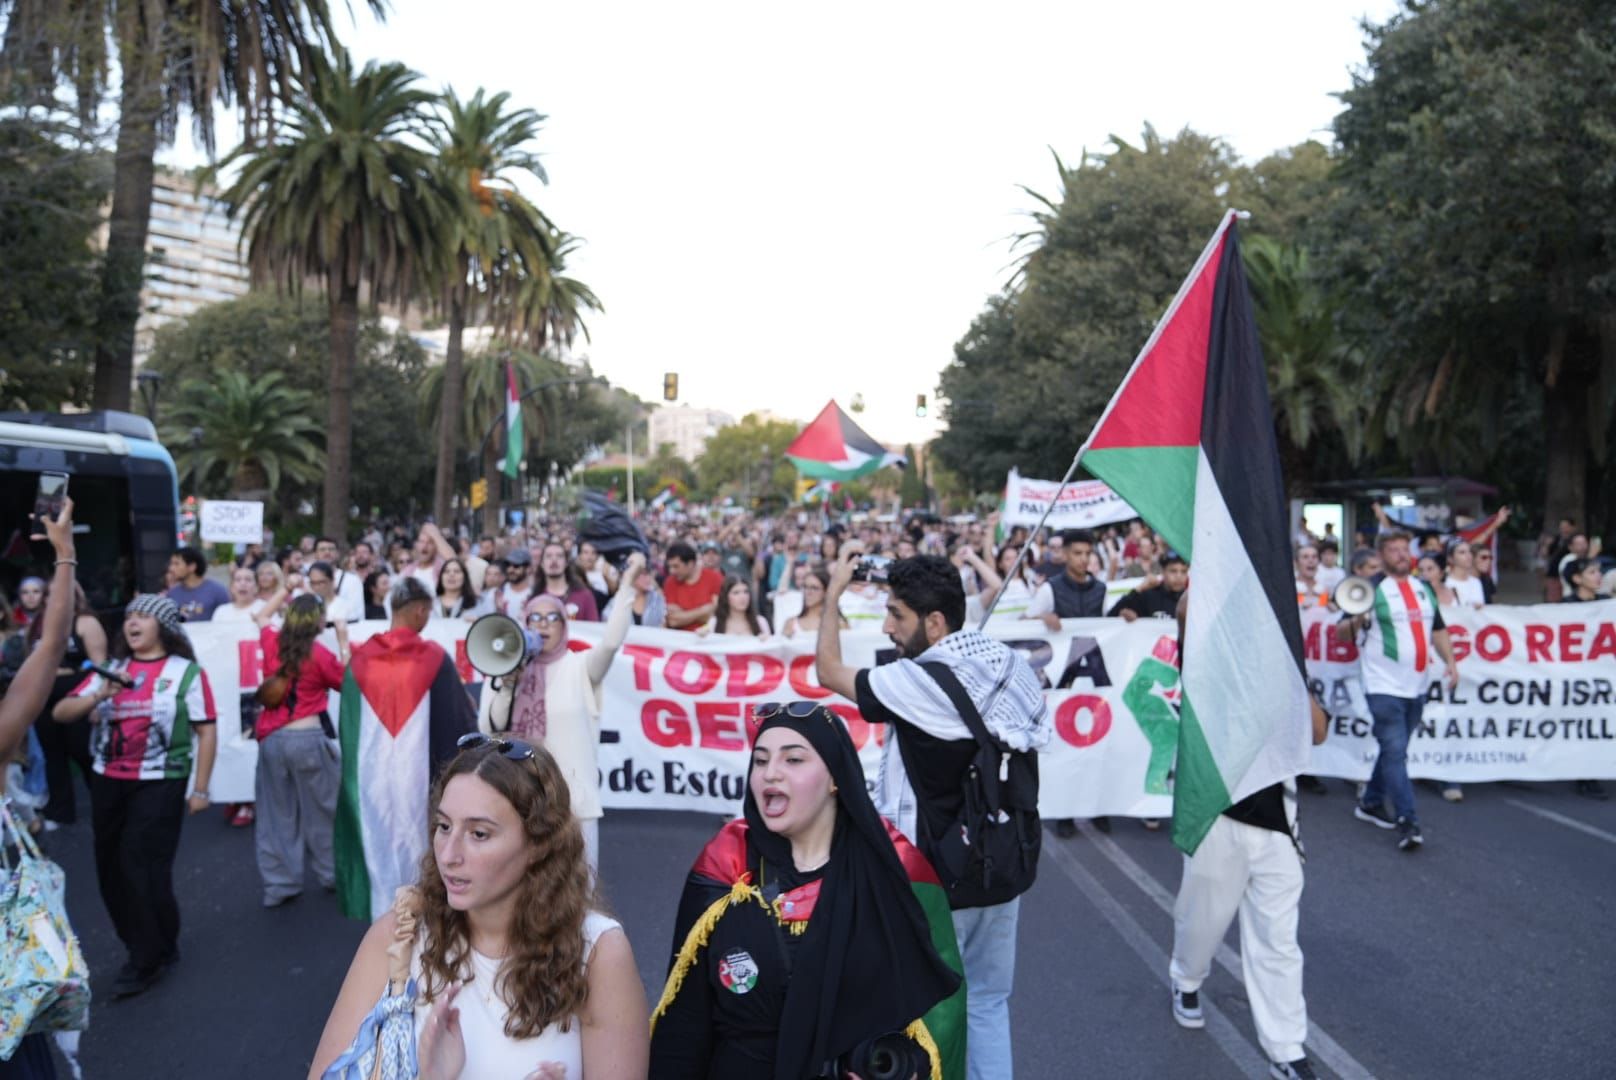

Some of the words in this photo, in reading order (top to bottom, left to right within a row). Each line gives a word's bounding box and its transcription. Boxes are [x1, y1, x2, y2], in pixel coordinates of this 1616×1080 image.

[1477, 679, 1551, 706] CON
[1561, 678, 1616, 706] ISR
[1507, 717, 1616, 740] FLOTILL
